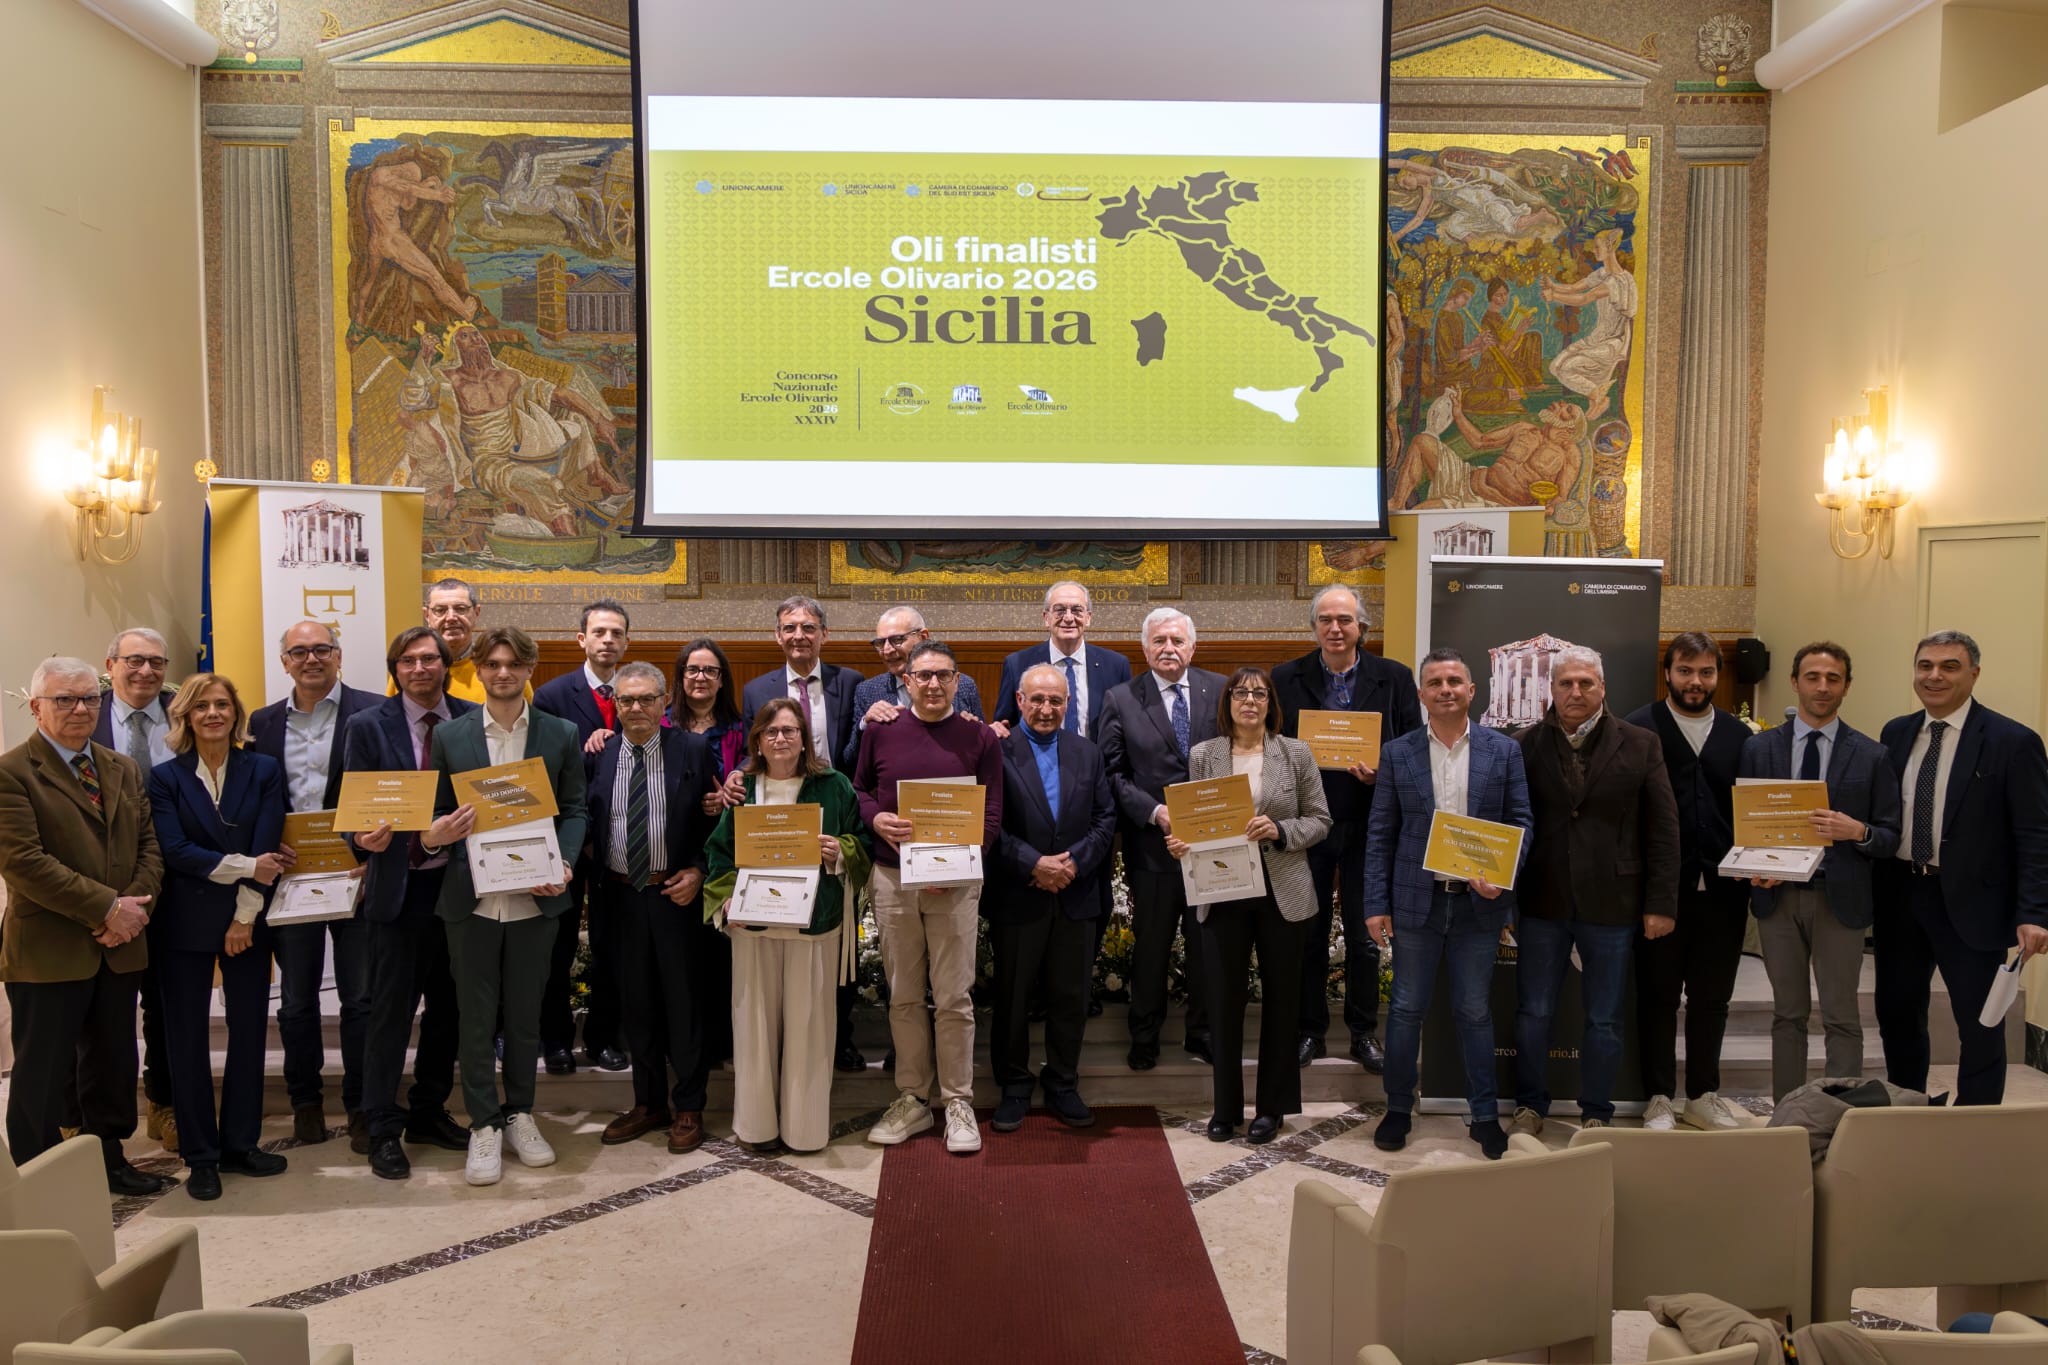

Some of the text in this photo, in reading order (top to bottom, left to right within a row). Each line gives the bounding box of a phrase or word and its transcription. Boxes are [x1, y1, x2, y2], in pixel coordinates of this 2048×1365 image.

[890, 235, 1097, 264] Oli finalisti
[768, 266, 1097, 290] Ercole Olivario 2026
[864, 294, 1097, 345] Sicilia
[776, 370, 838, 380] Concorso
[773, 382, 838, 392] Nazionale
[740, 392, 838, 402] Ercole Olivario
[809, 404, 838, 414] 2026
[1007, 402, 1068, 411] Ercole Olivario
[794, 416, 839, 424] XXXIV
[479, 587, 544, 600] ERCOLE
